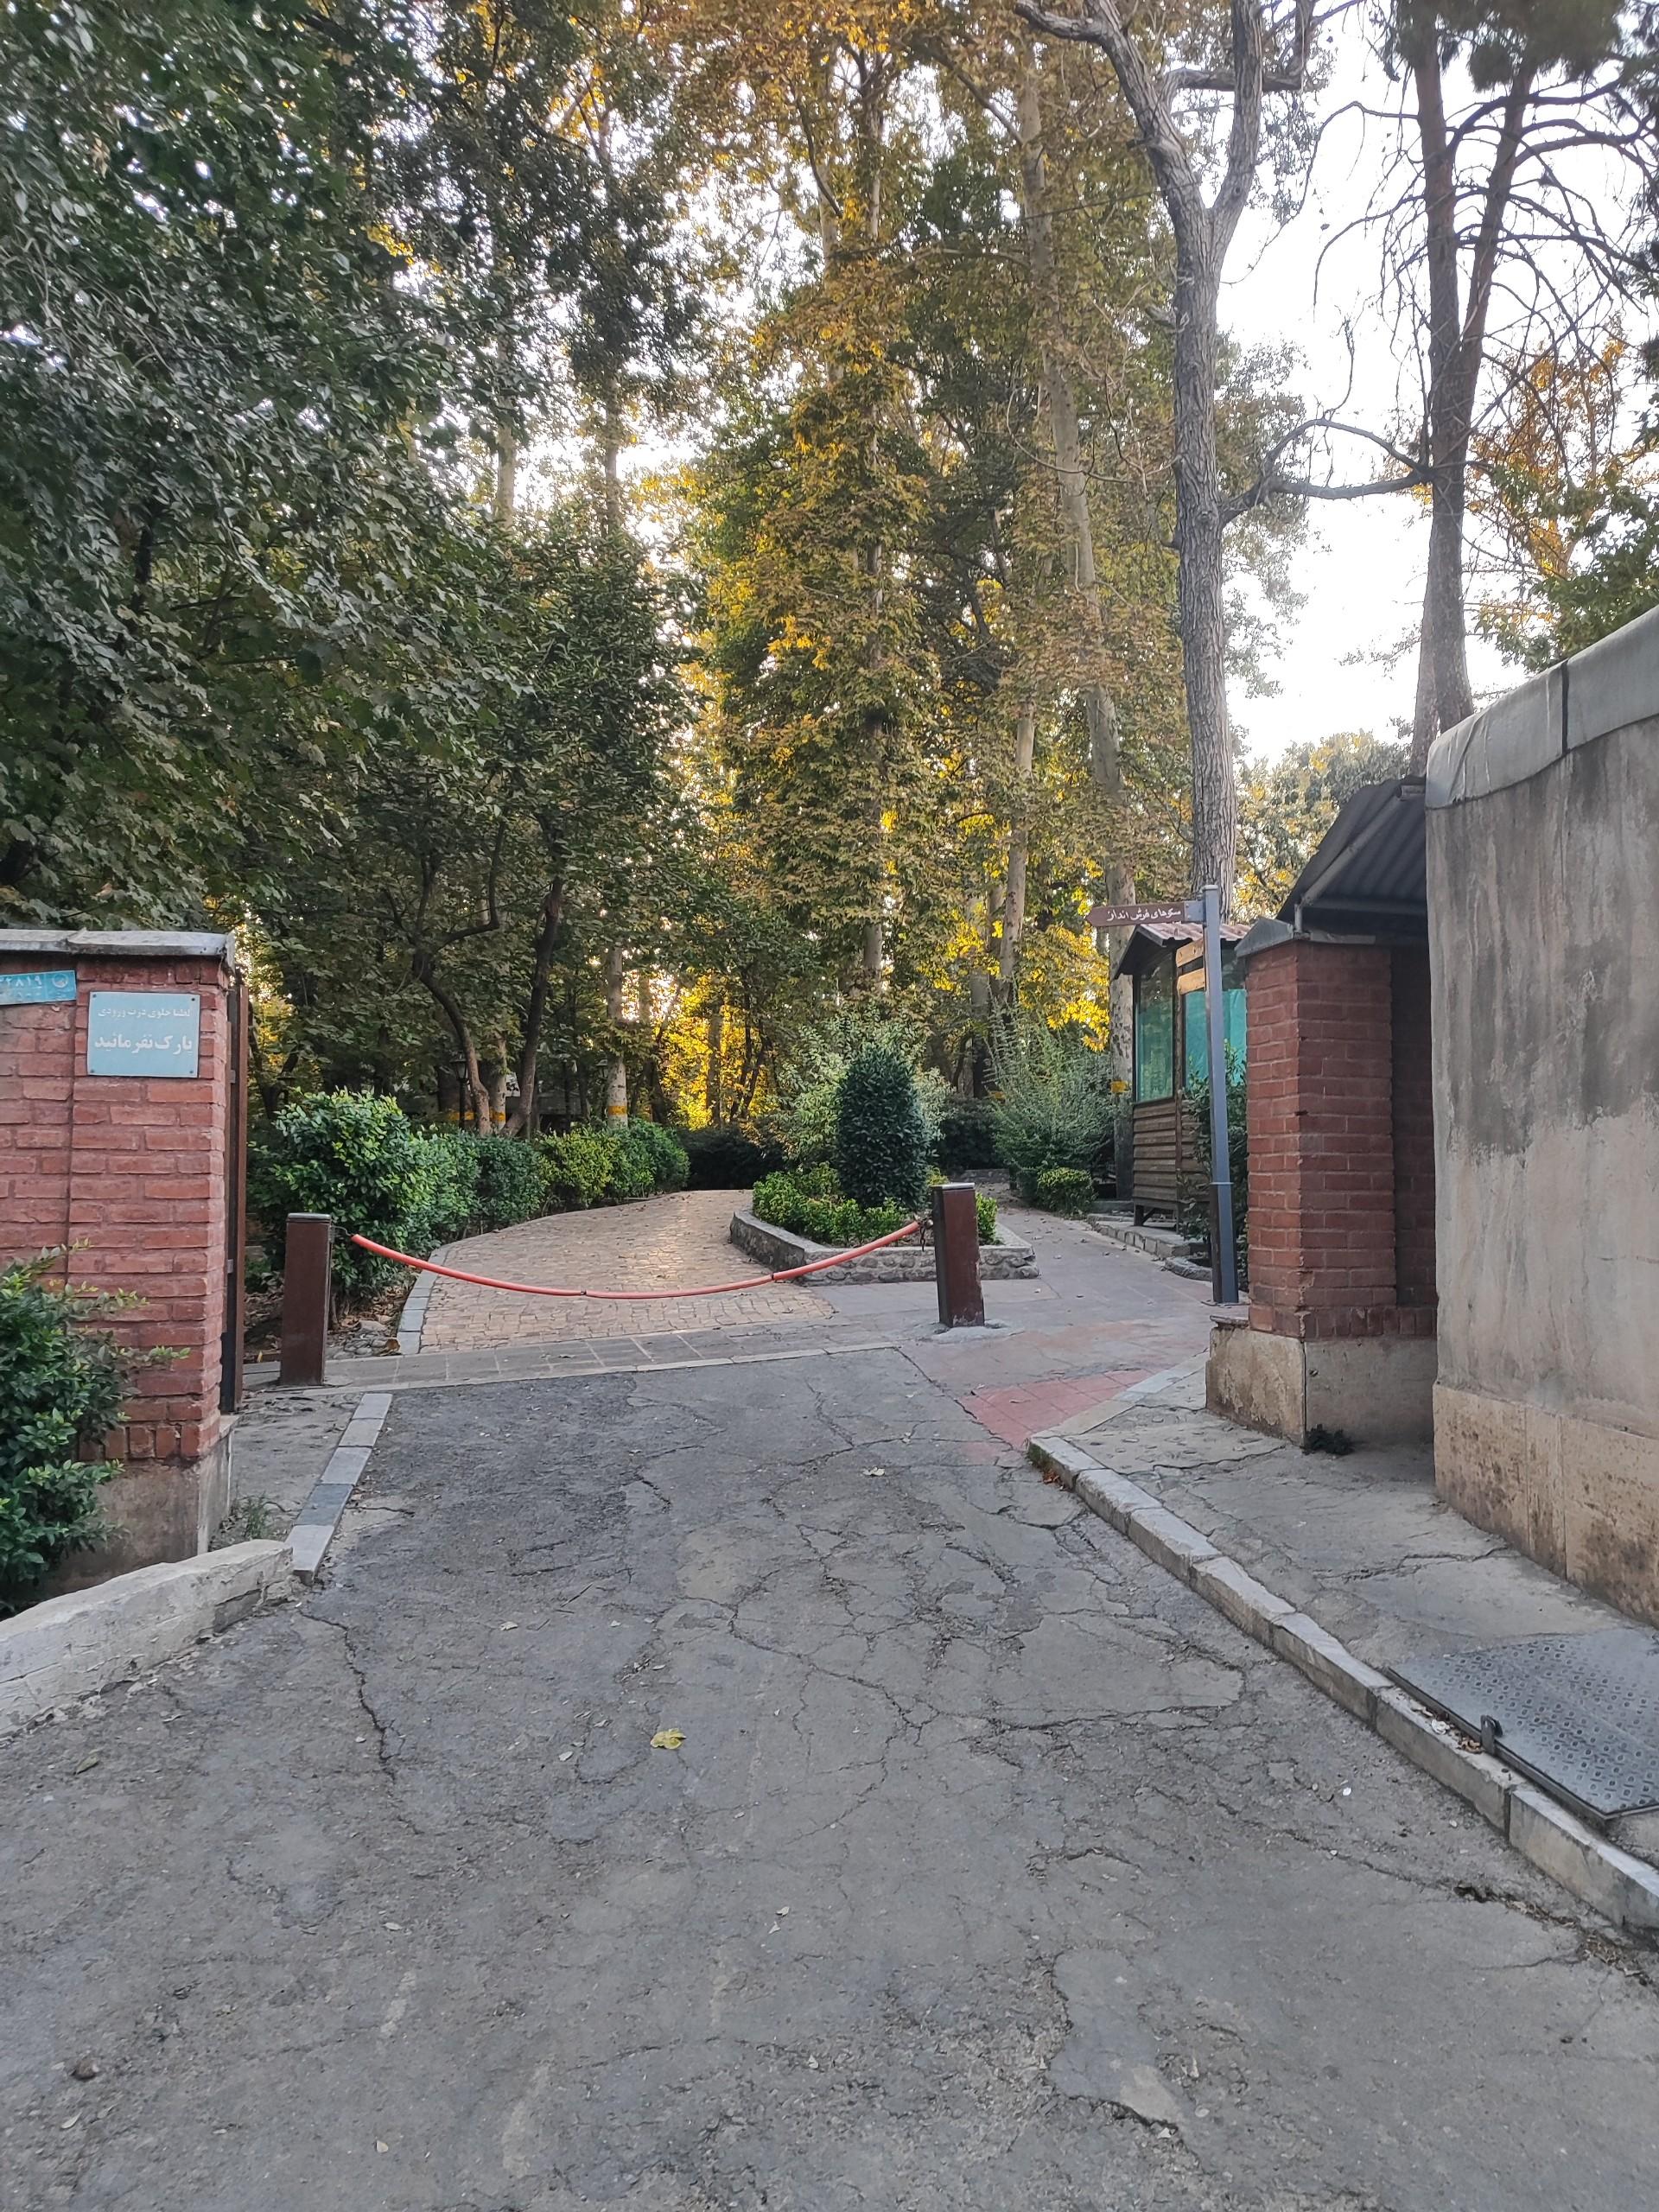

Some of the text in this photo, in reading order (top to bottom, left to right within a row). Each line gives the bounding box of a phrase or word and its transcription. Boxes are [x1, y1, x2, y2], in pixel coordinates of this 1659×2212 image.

[1107, 909, 1128, 921] انداز
[1130, 906, 1150, 920] فرش
[98, 1008, 125, 1018] ورودی
[147, 1007, 171, 1018] جلوی
[154, 1035, 194, 1055] پارک
